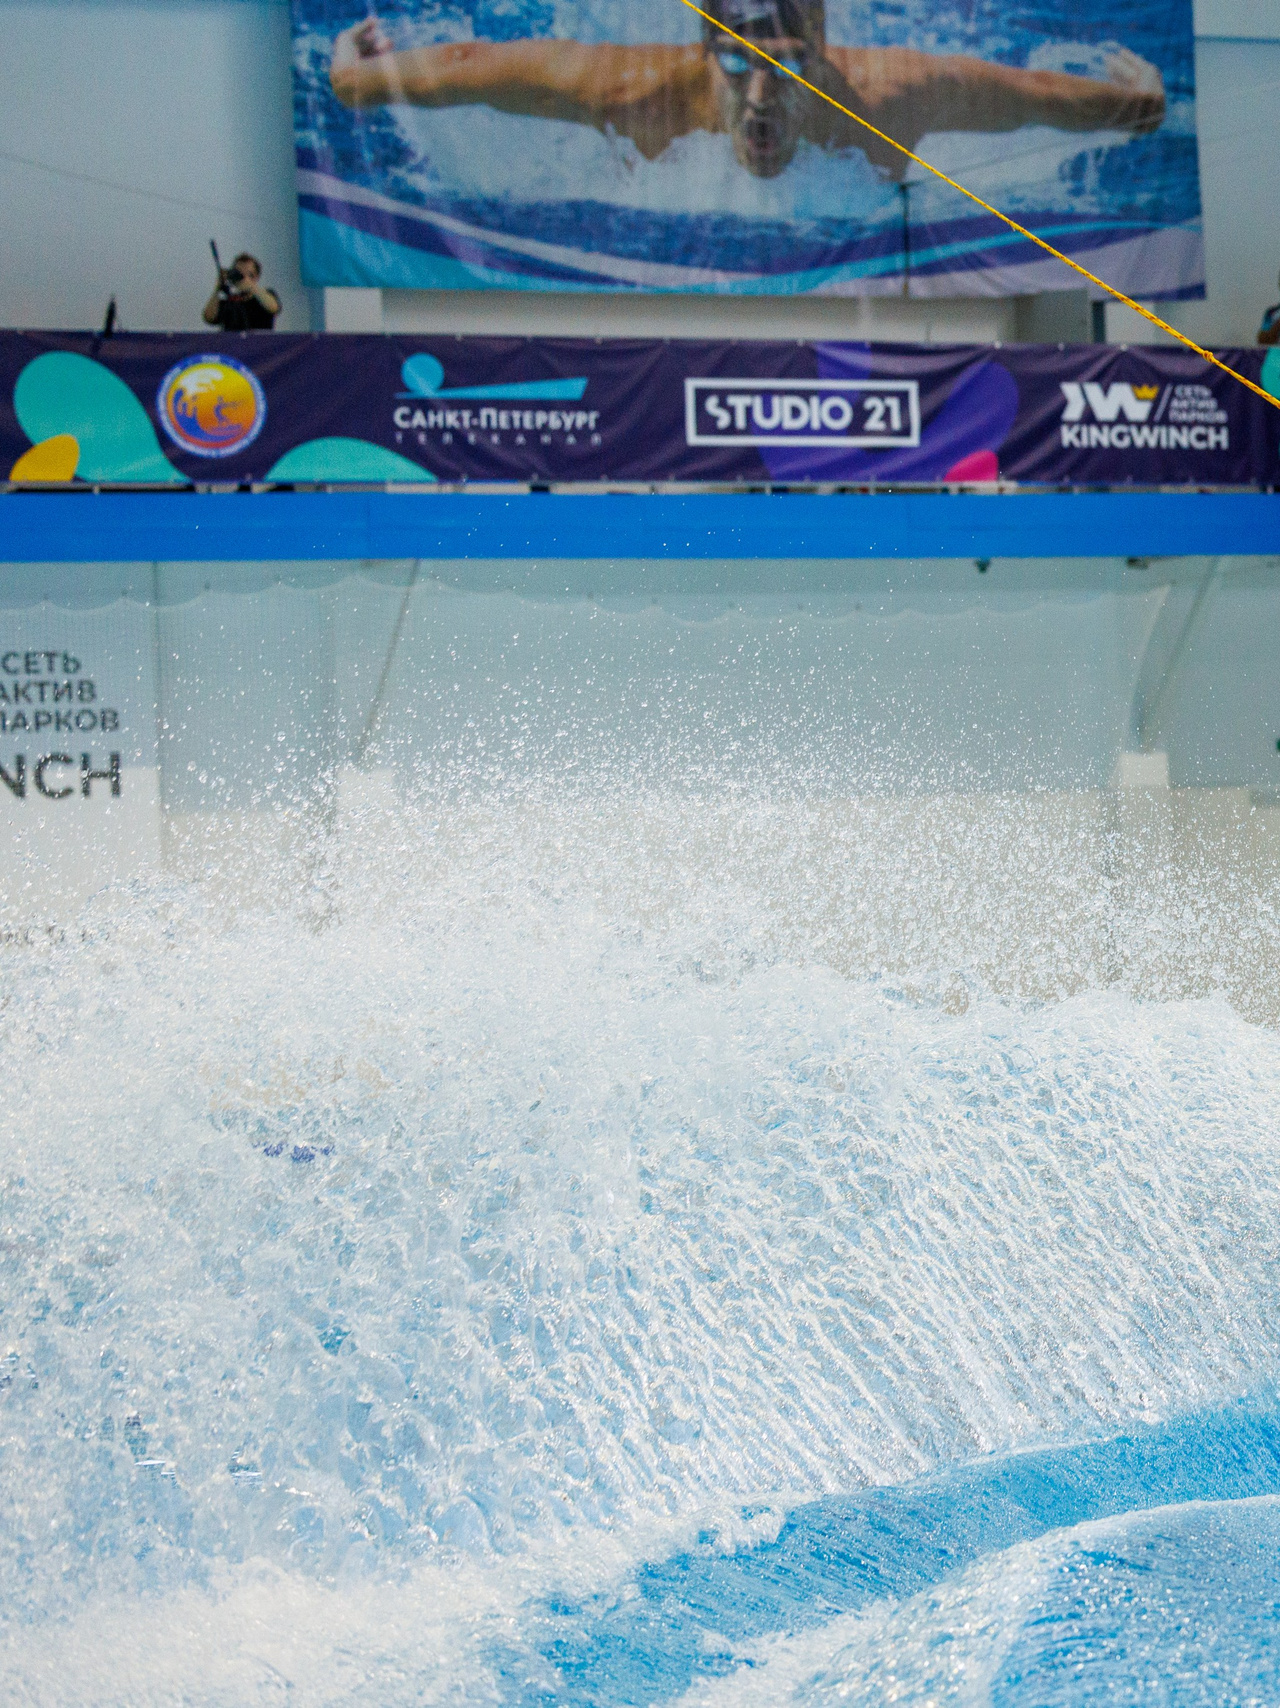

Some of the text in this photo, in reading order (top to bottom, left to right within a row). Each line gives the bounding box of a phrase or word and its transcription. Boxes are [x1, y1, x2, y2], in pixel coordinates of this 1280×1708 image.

[705, 395, 901, 431] STUDIO 21
[1060, 424, 1229, 450] KINGWINCH
[1, 651, 82, 674] СЕТЬ
